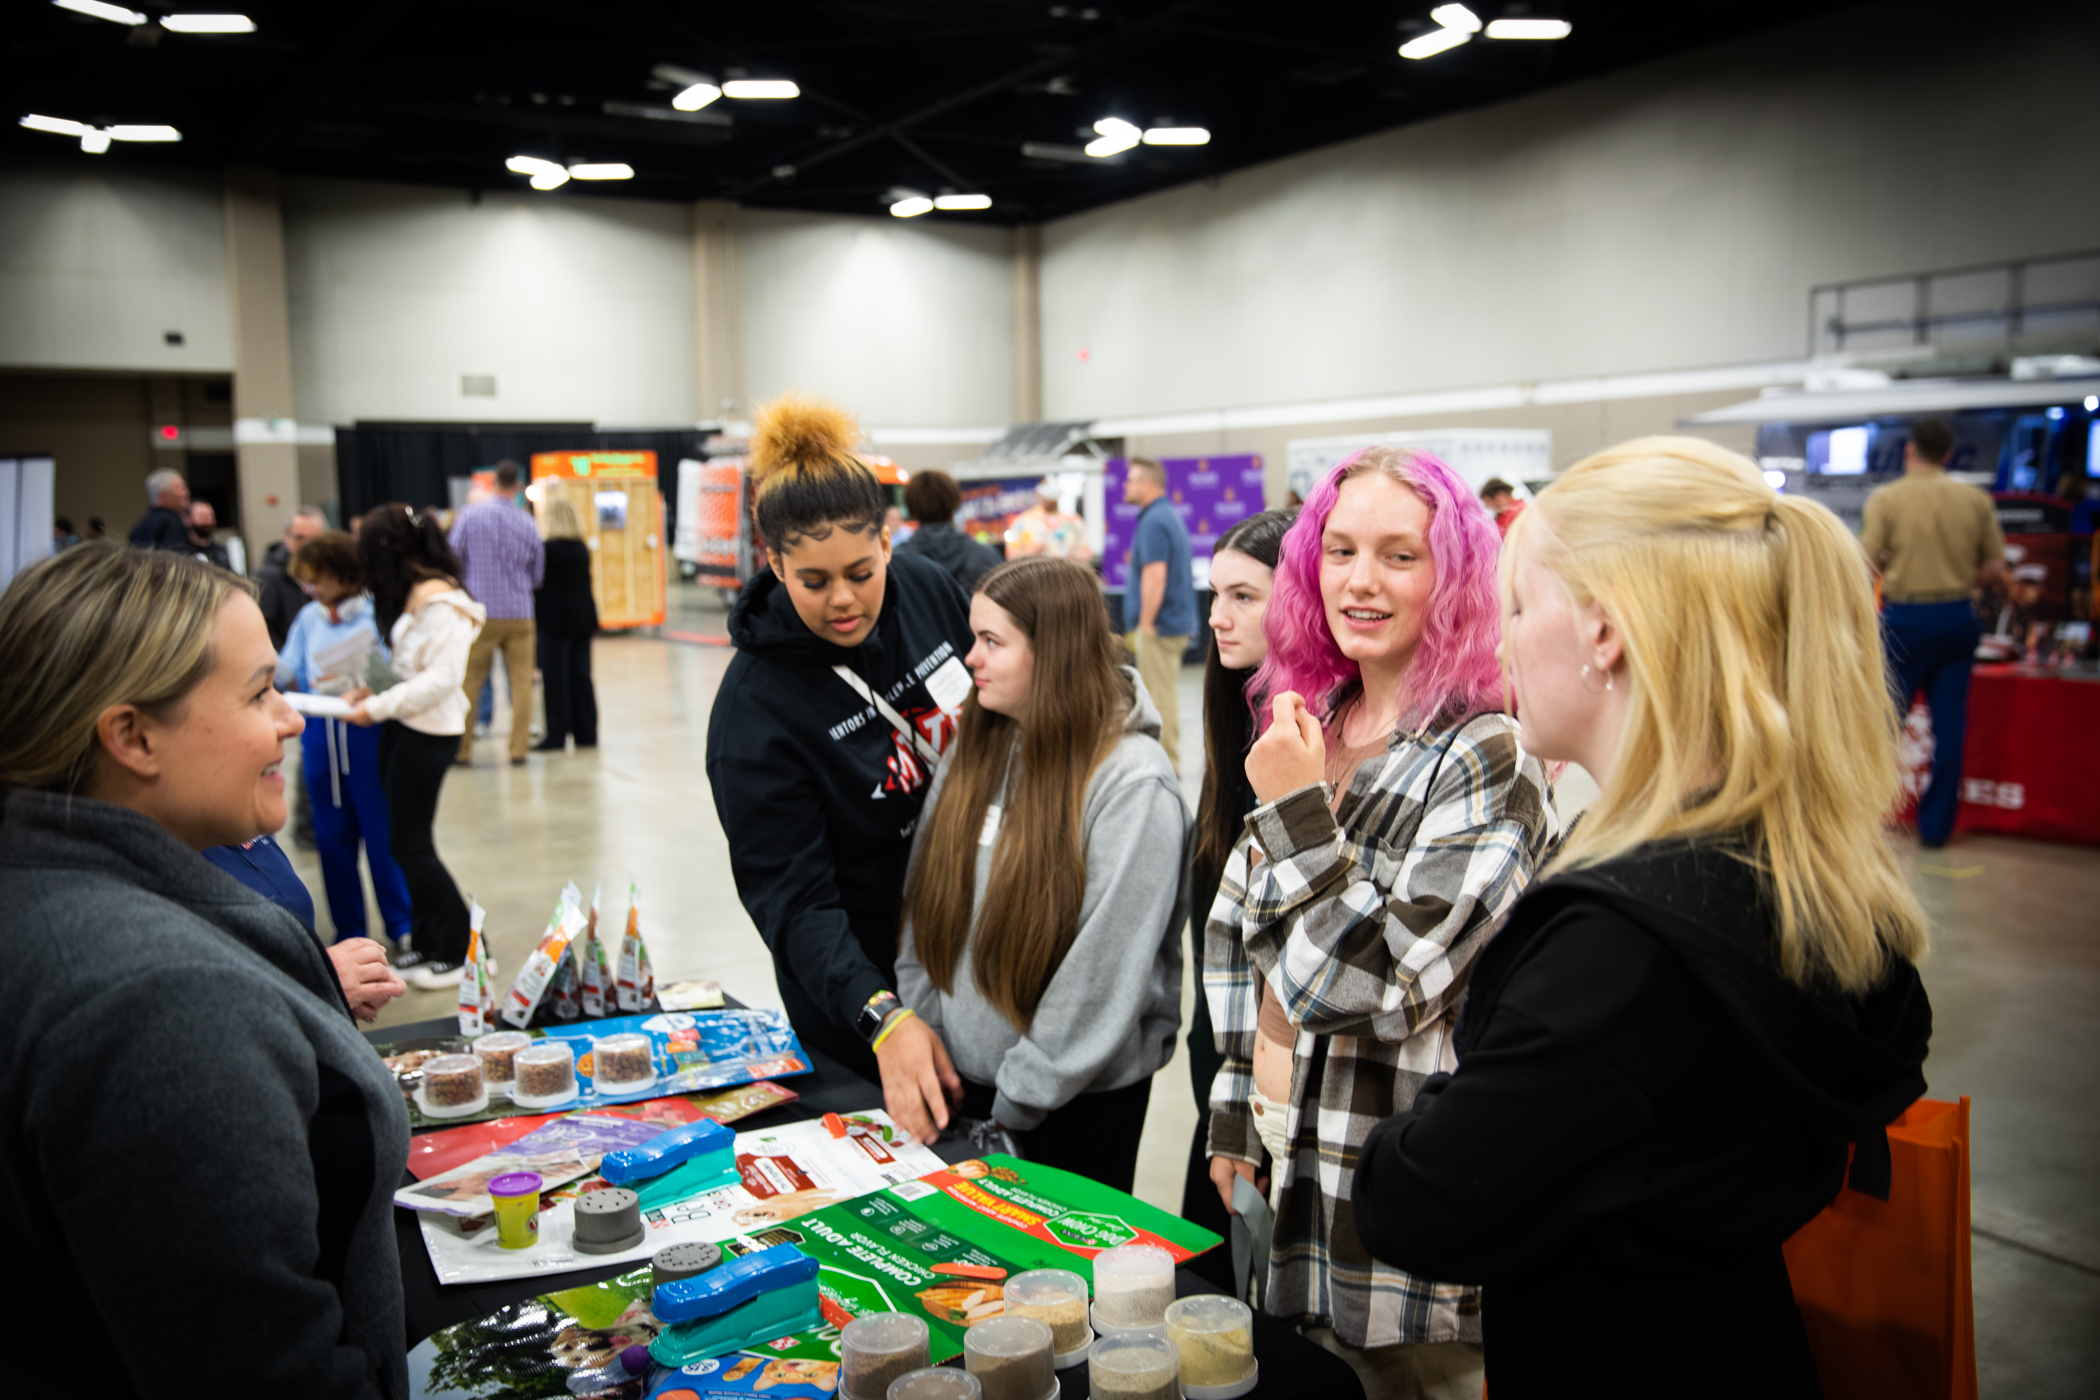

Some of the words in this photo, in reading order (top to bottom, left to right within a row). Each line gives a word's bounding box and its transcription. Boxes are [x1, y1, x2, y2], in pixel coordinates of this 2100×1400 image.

[953, 1181, 996, 1207] VALUE
[977, 1178, 1013, 1197] ADULT
[992, 1203, 1042, 1226] SMART
[1009, 1194, 1059, 1217] COMPLETE
[801, 1218, 853, 1246] ADULT
[1057, 1217, 1098, 1236] CHOW
[1094, 1229, 1127, 1246] DOG
[850, 1232, 892, 1256] FLAVOR
[845, 1245, 921, 1286] COMPLETE
[888, 1252, 936, 1279] CHICKEN
